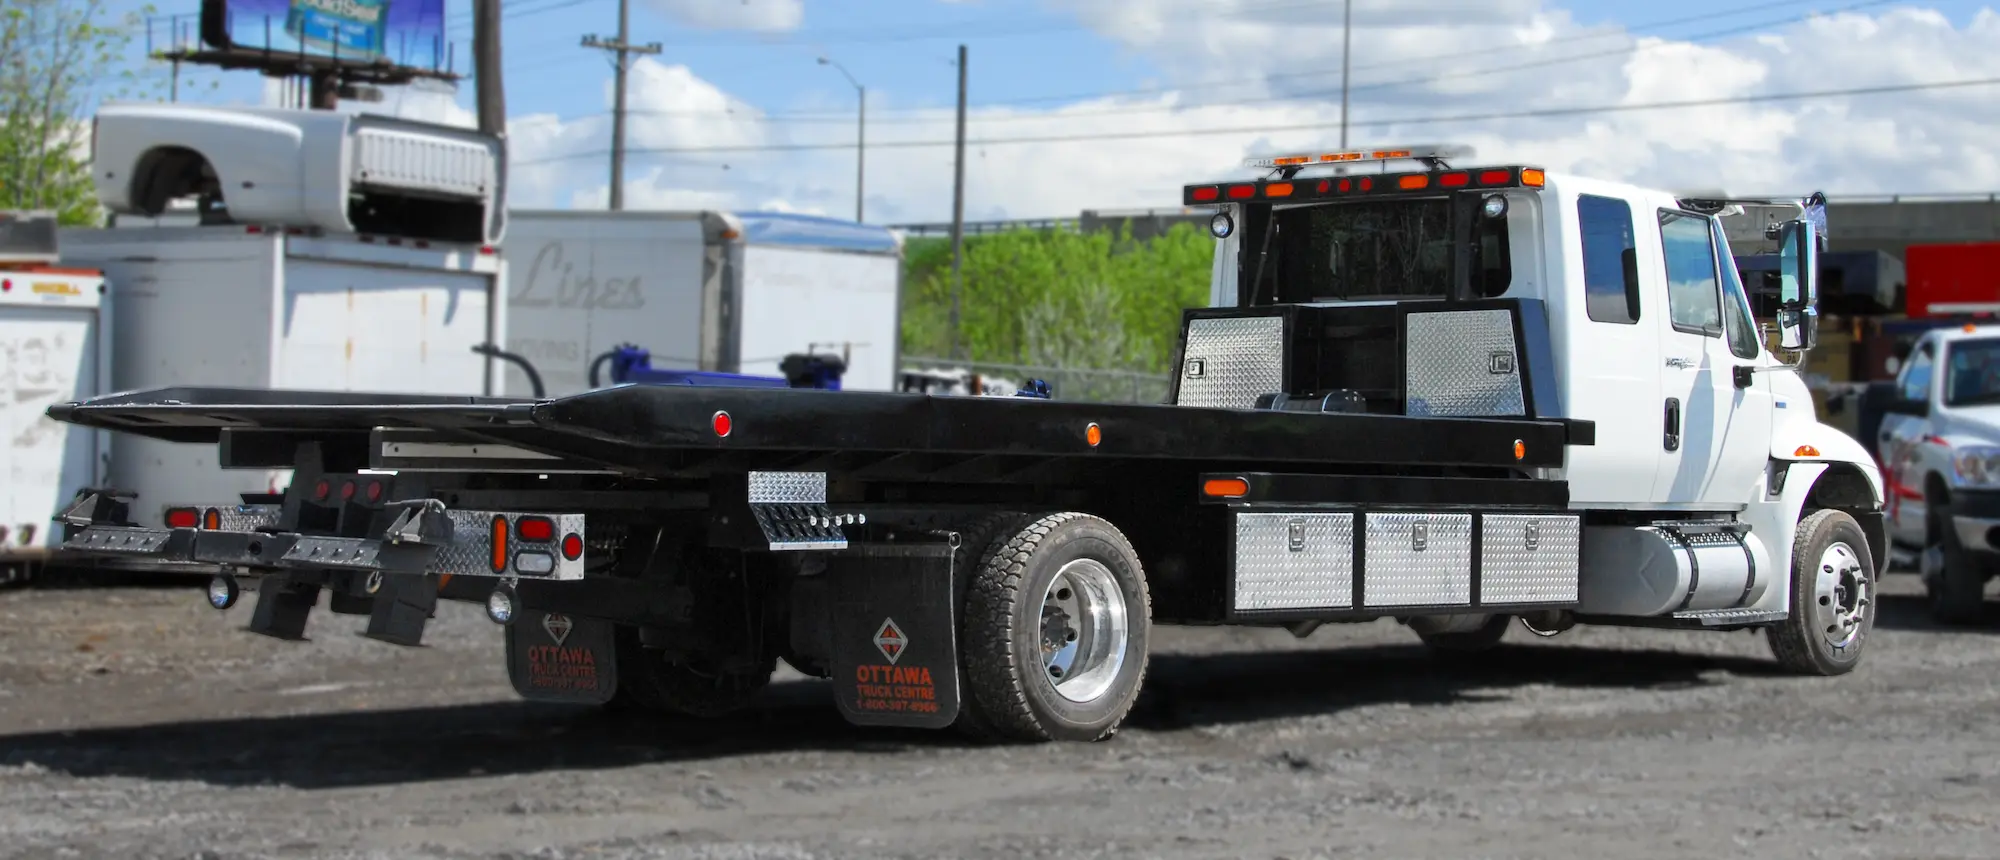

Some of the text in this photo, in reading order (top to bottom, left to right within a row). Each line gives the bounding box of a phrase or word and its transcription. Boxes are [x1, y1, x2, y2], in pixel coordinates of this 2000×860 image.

[507, 241, 645, 309] Lines
[528, 645, 595, 664] OTTAWA
[856, 665, 933, 685] OTTAWA
[857, 684, 935, 700] TRUCK CENTRE
